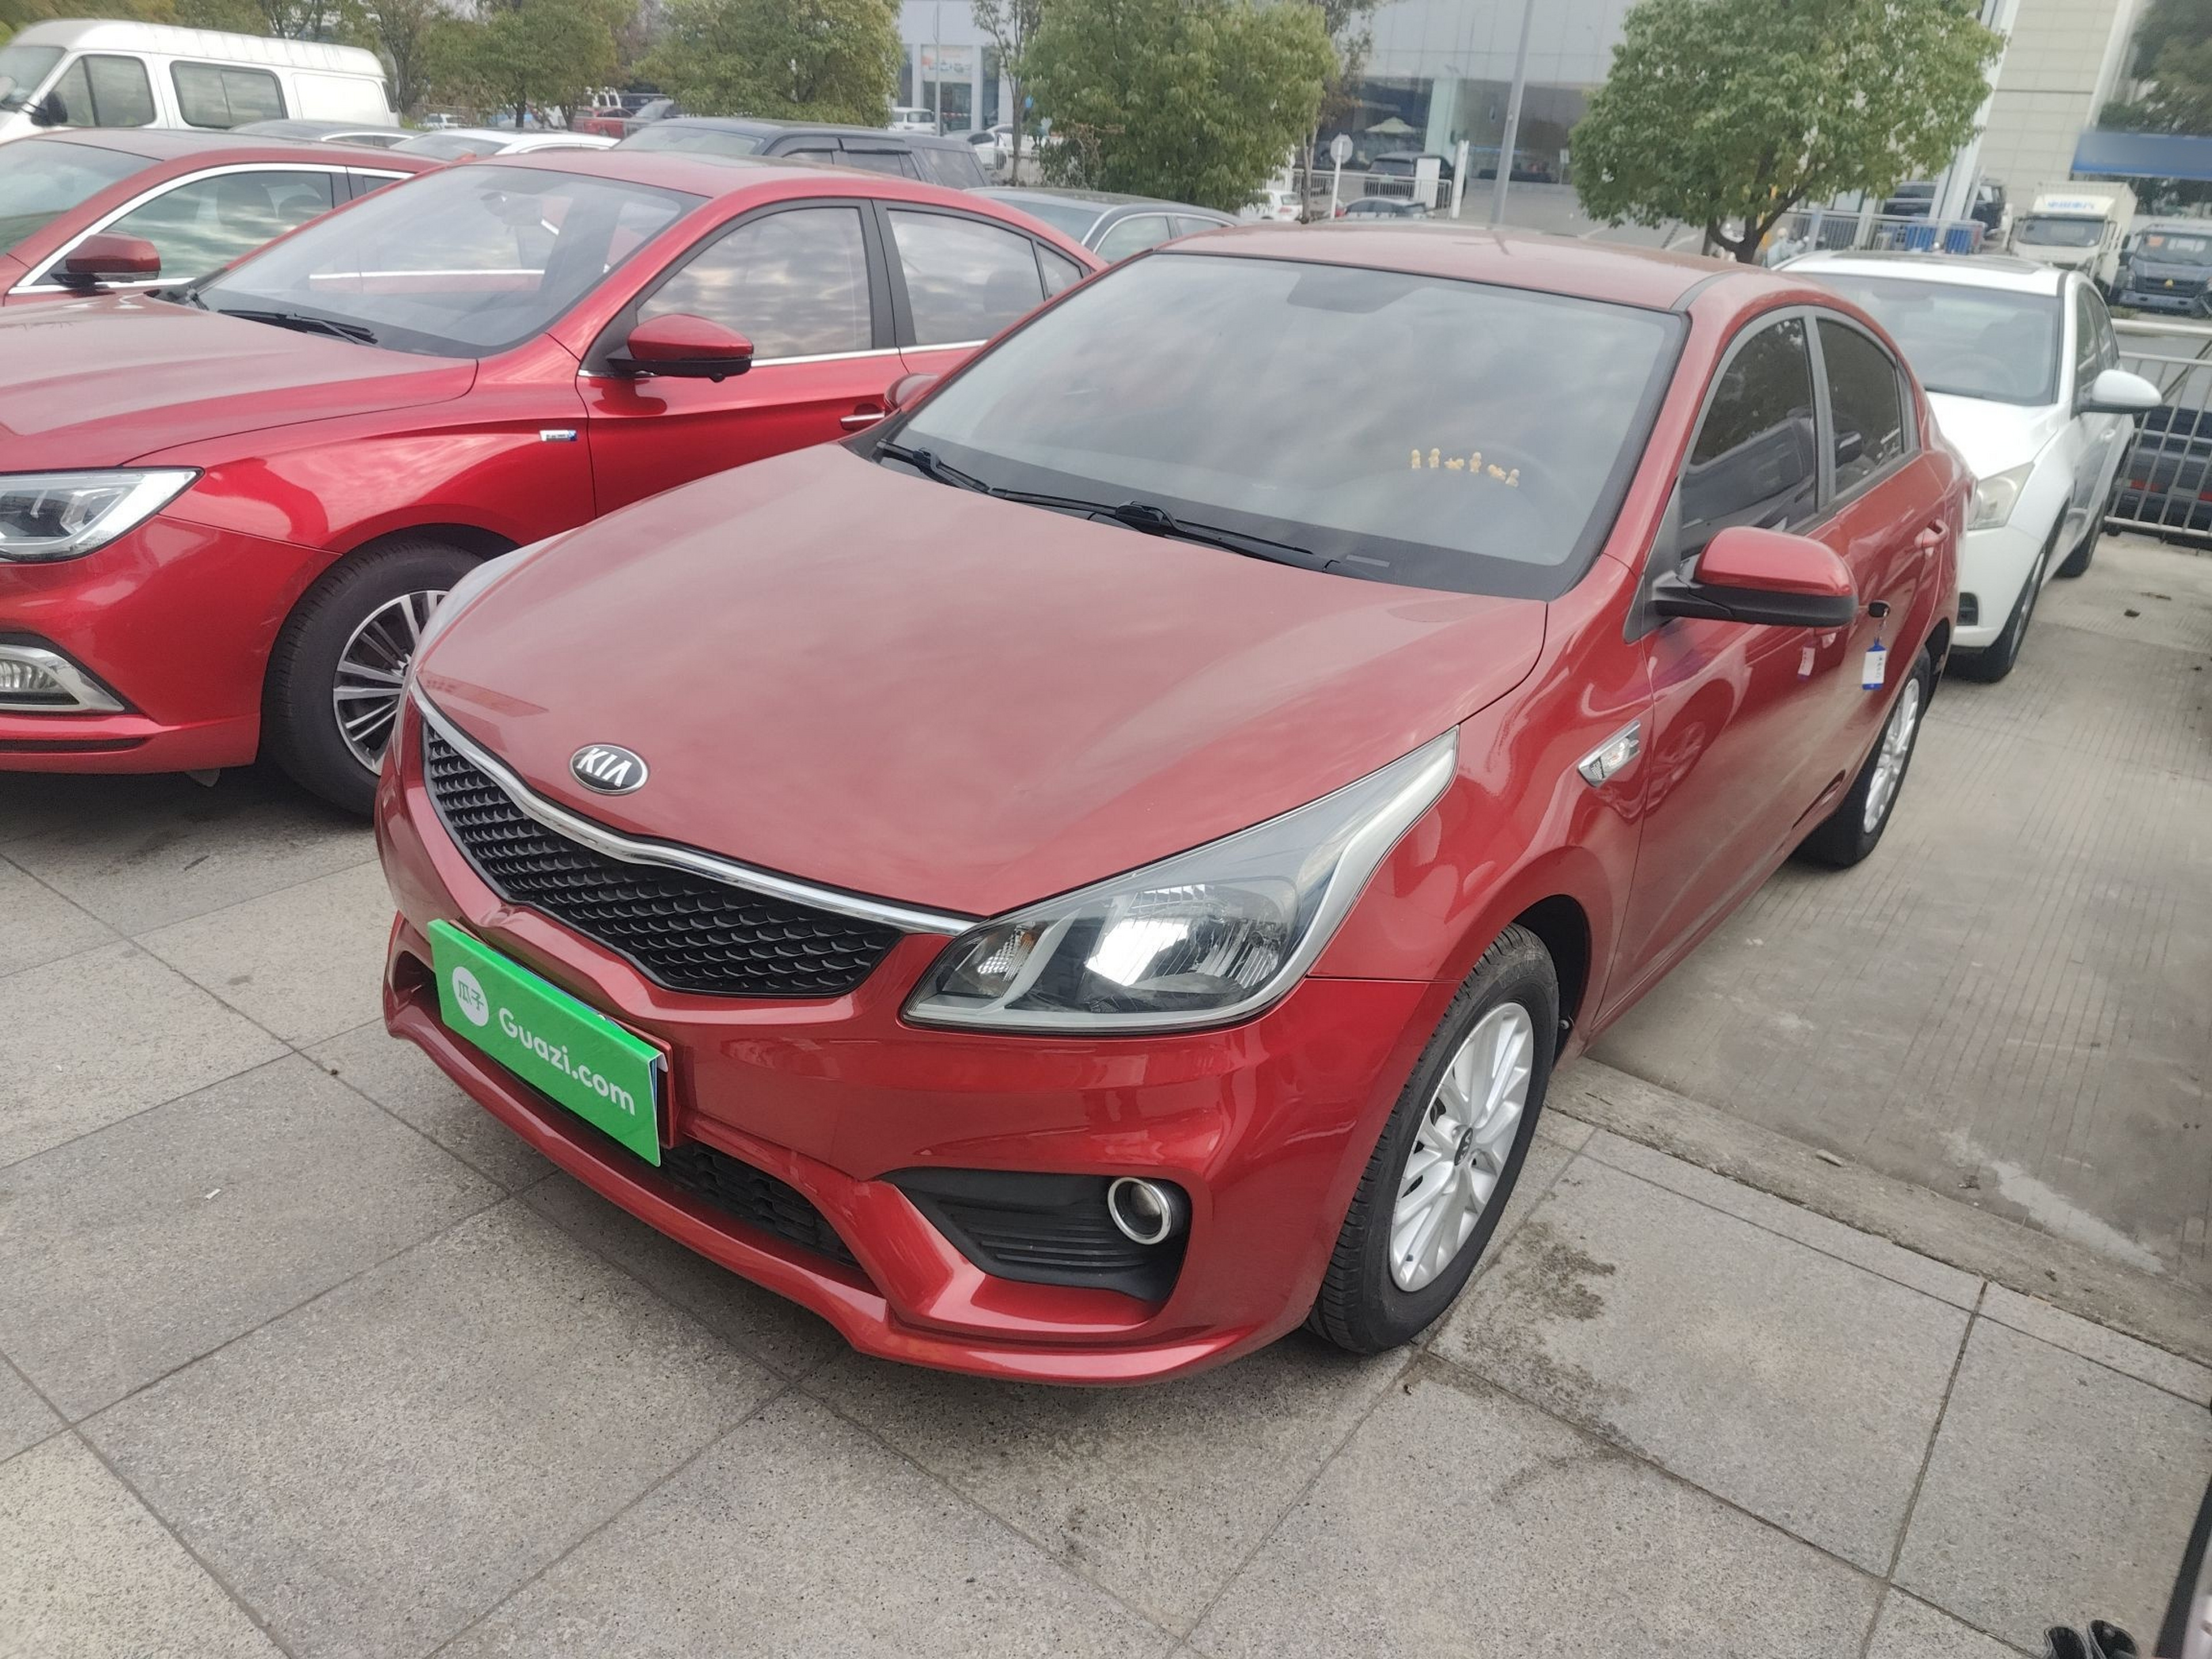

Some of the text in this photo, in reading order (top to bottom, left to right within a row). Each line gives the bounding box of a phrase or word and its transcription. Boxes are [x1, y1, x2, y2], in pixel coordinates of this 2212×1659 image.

[577, 747, 632, 787] KIA
[458, 980, 484, 1012] 瓜子
[499, 1007, 635, 1116] Guazi.com
